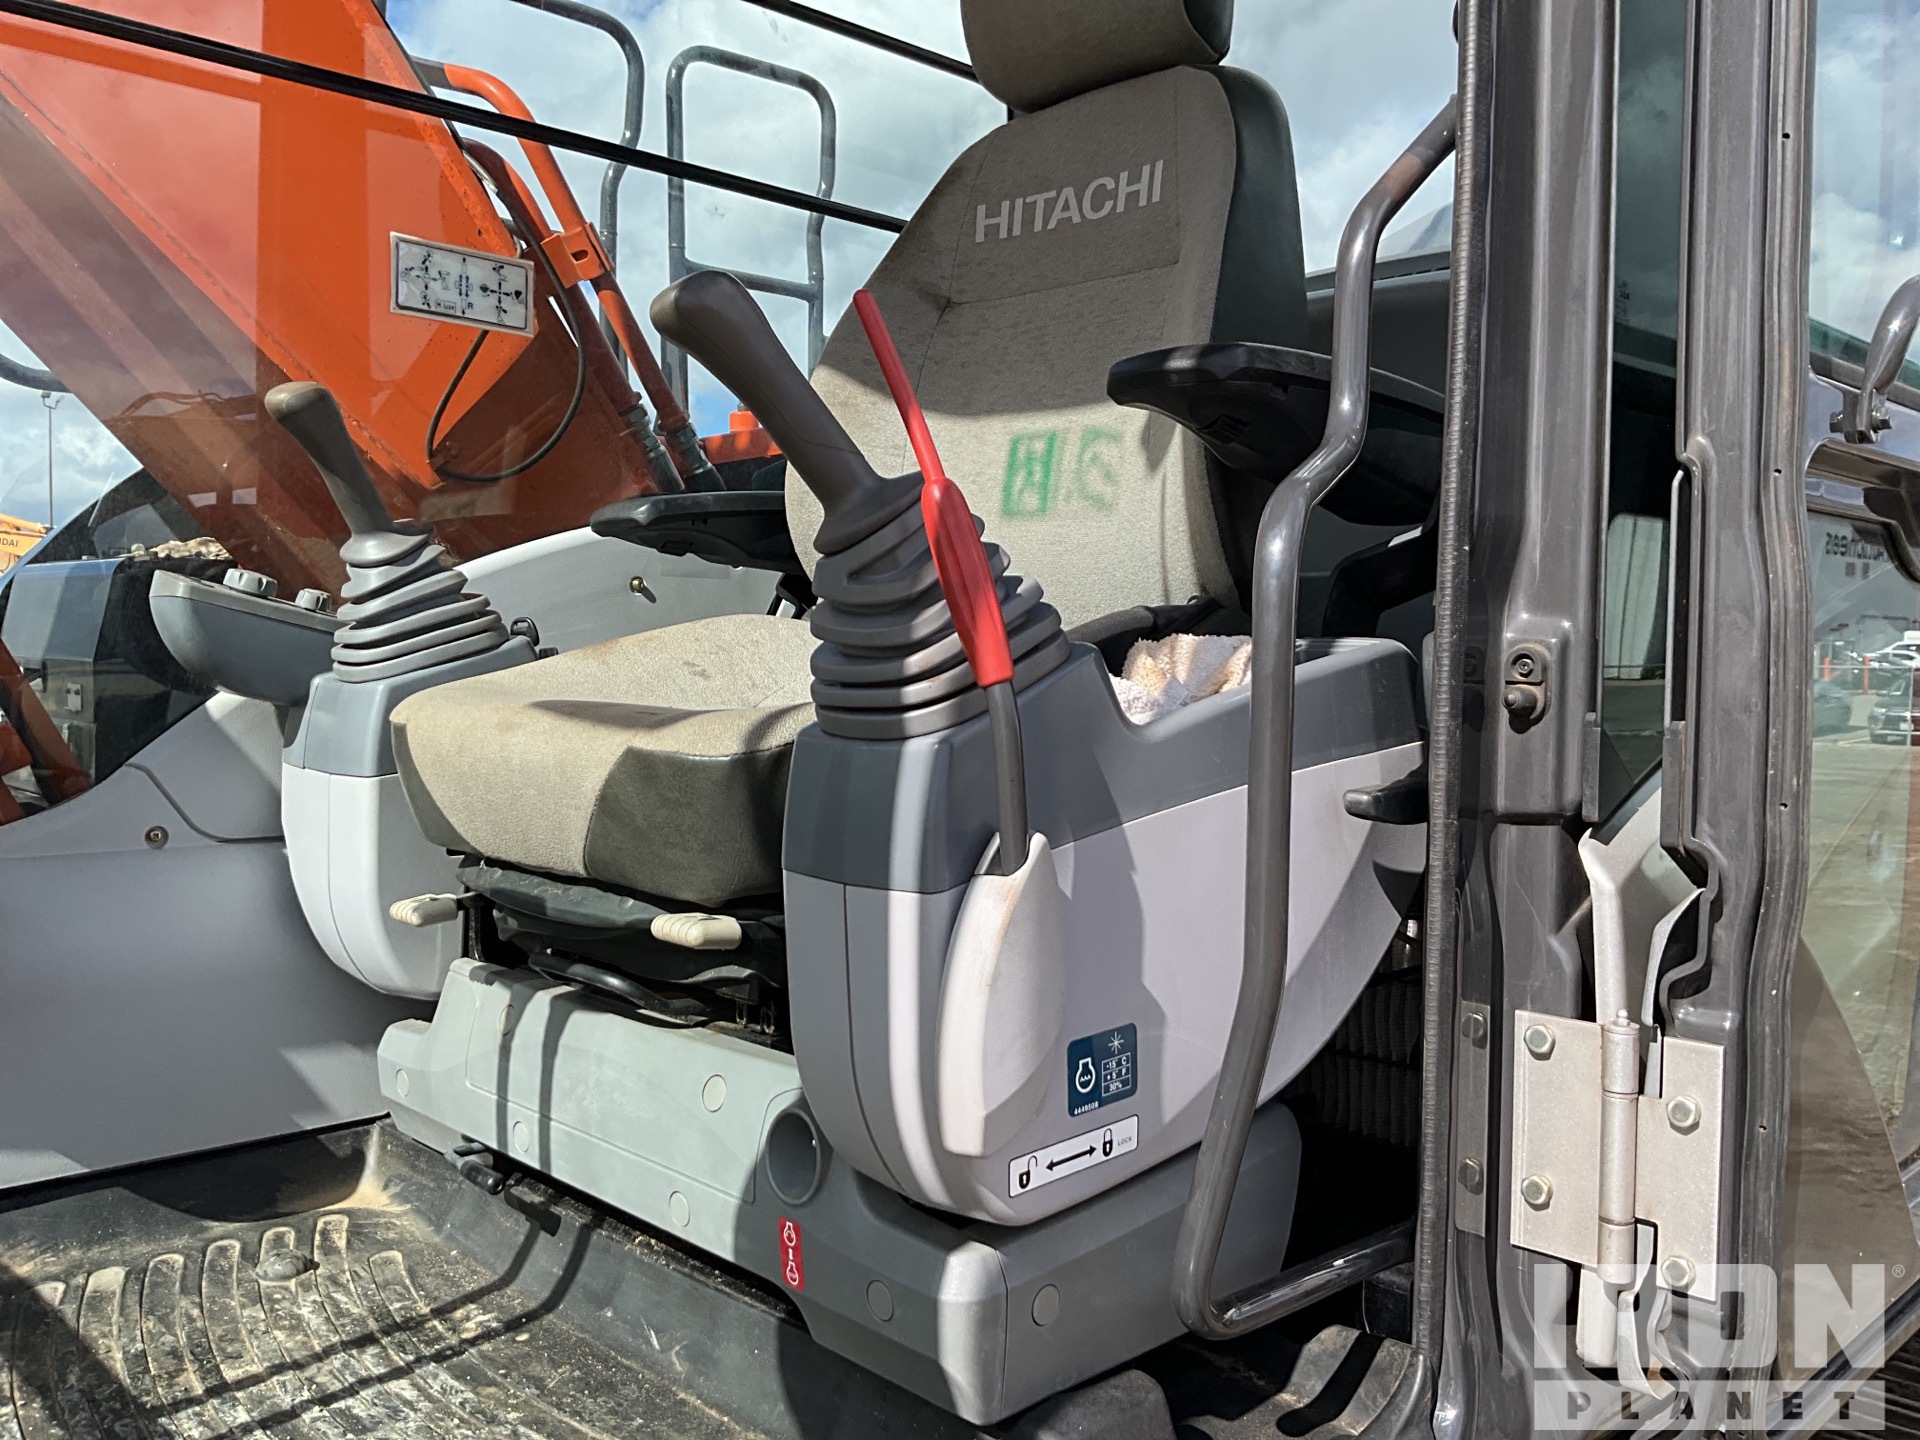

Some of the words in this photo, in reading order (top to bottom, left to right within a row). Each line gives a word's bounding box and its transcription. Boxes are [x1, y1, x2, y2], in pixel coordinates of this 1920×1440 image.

[975, 159, 1164, 243] HITACHI
[1121, 1056, 1127, 1065] C
[1121, 1067, 1126, 1076] F
[1109, 1081, 1122, 1092] 30%
[1117, 1136, 1133, 1147] LOCK
